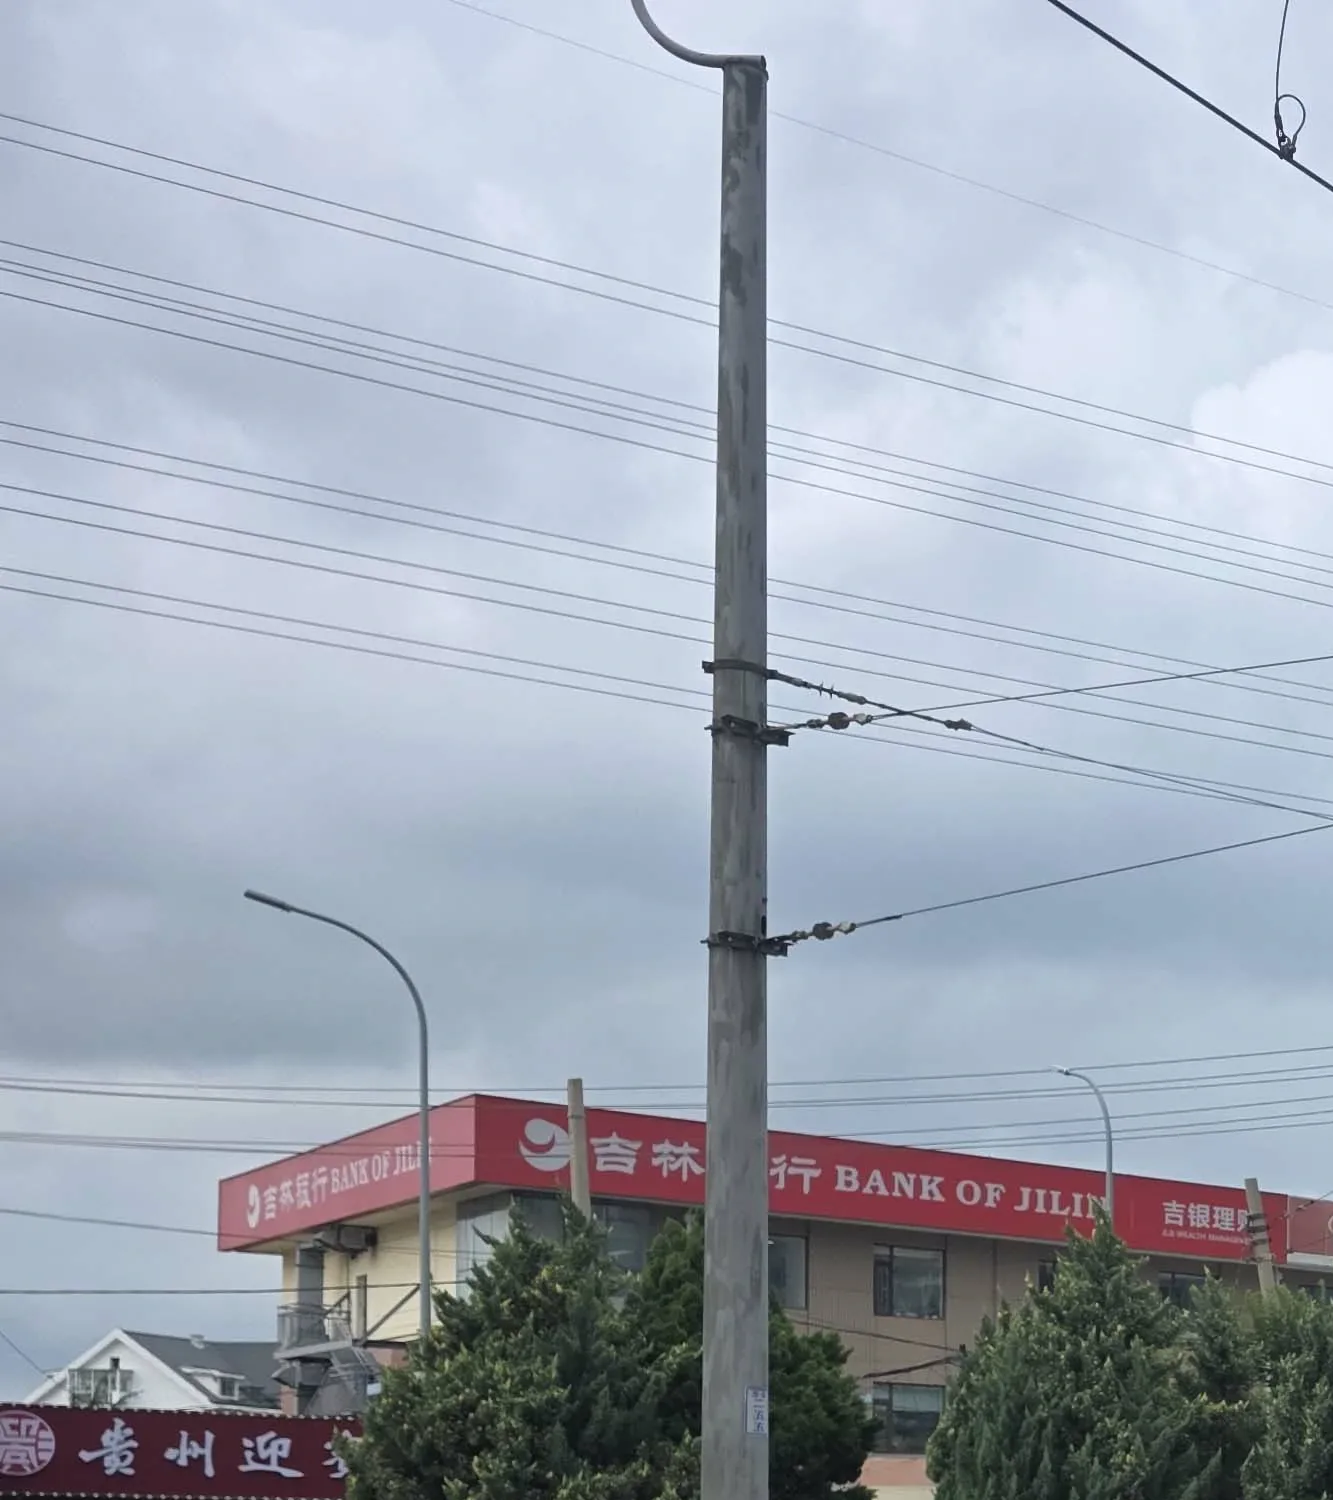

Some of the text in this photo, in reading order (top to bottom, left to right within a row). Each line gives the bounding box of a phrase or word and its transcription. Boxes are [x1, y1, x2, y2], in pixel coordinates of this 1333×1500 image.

[331, 1155, 369, 1193] BANK
[371, 1151, 391, 1179] OF
[590, 1132, 821, 1194] 吉林行
[835, 1164, 945, 1202] BANK
[956, 1180, 1006, 1208] OF
[263, 1166, 328, 1220] 吉林银行
